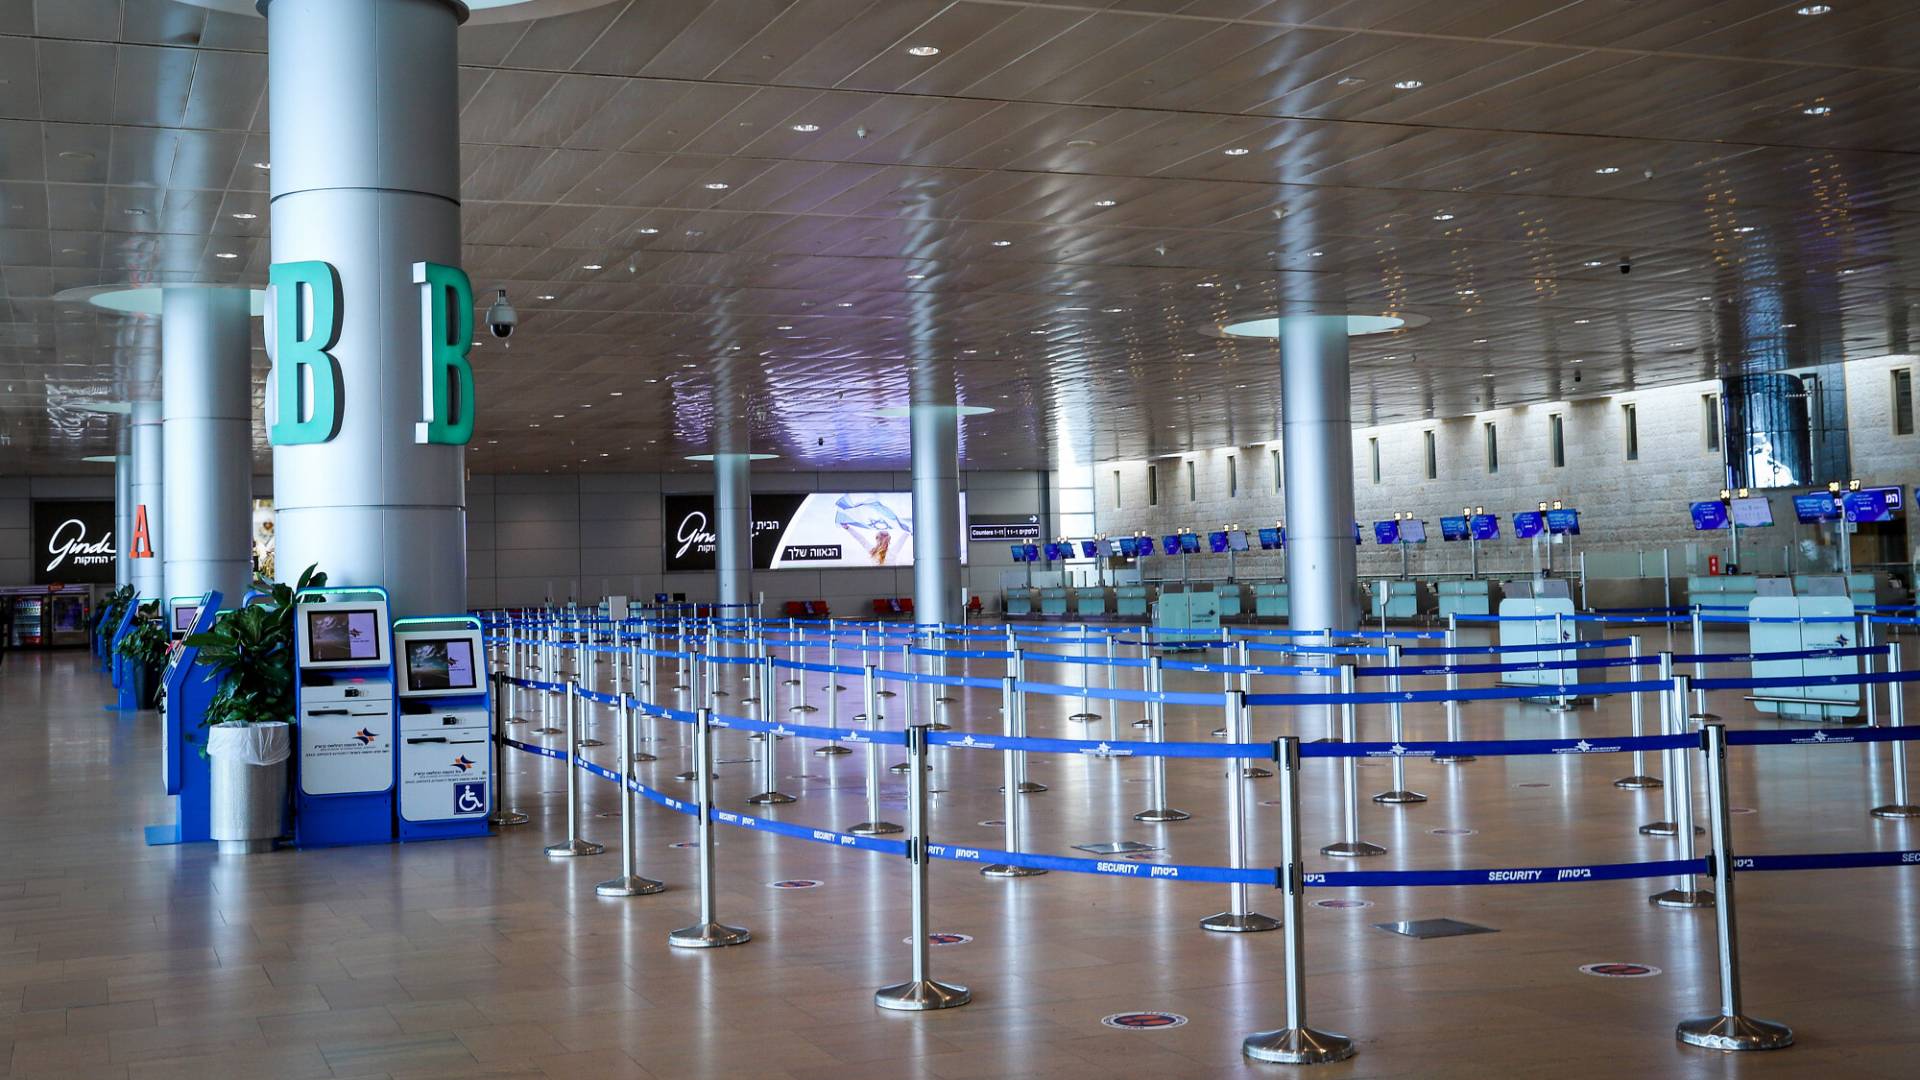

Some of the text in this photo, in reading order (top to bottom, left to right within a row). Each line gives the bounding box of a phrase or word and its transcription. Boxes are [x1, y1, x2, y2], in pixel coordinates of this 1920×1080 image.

[270, 260, 344, 445] B
[413, 261, 475, 445] B
[1850, 480, 1860, 490] 37
[129, 505, 153, 558] A
[756, 521, 779, 530] הבית
[788, 547, 807, 560] שלך
[928, 845, 945, 855] RITY
[1097, 862, 1178, 877] SECURITY ביטחון
[1488, 868, 1591, 881] SECURITY ביטחון
